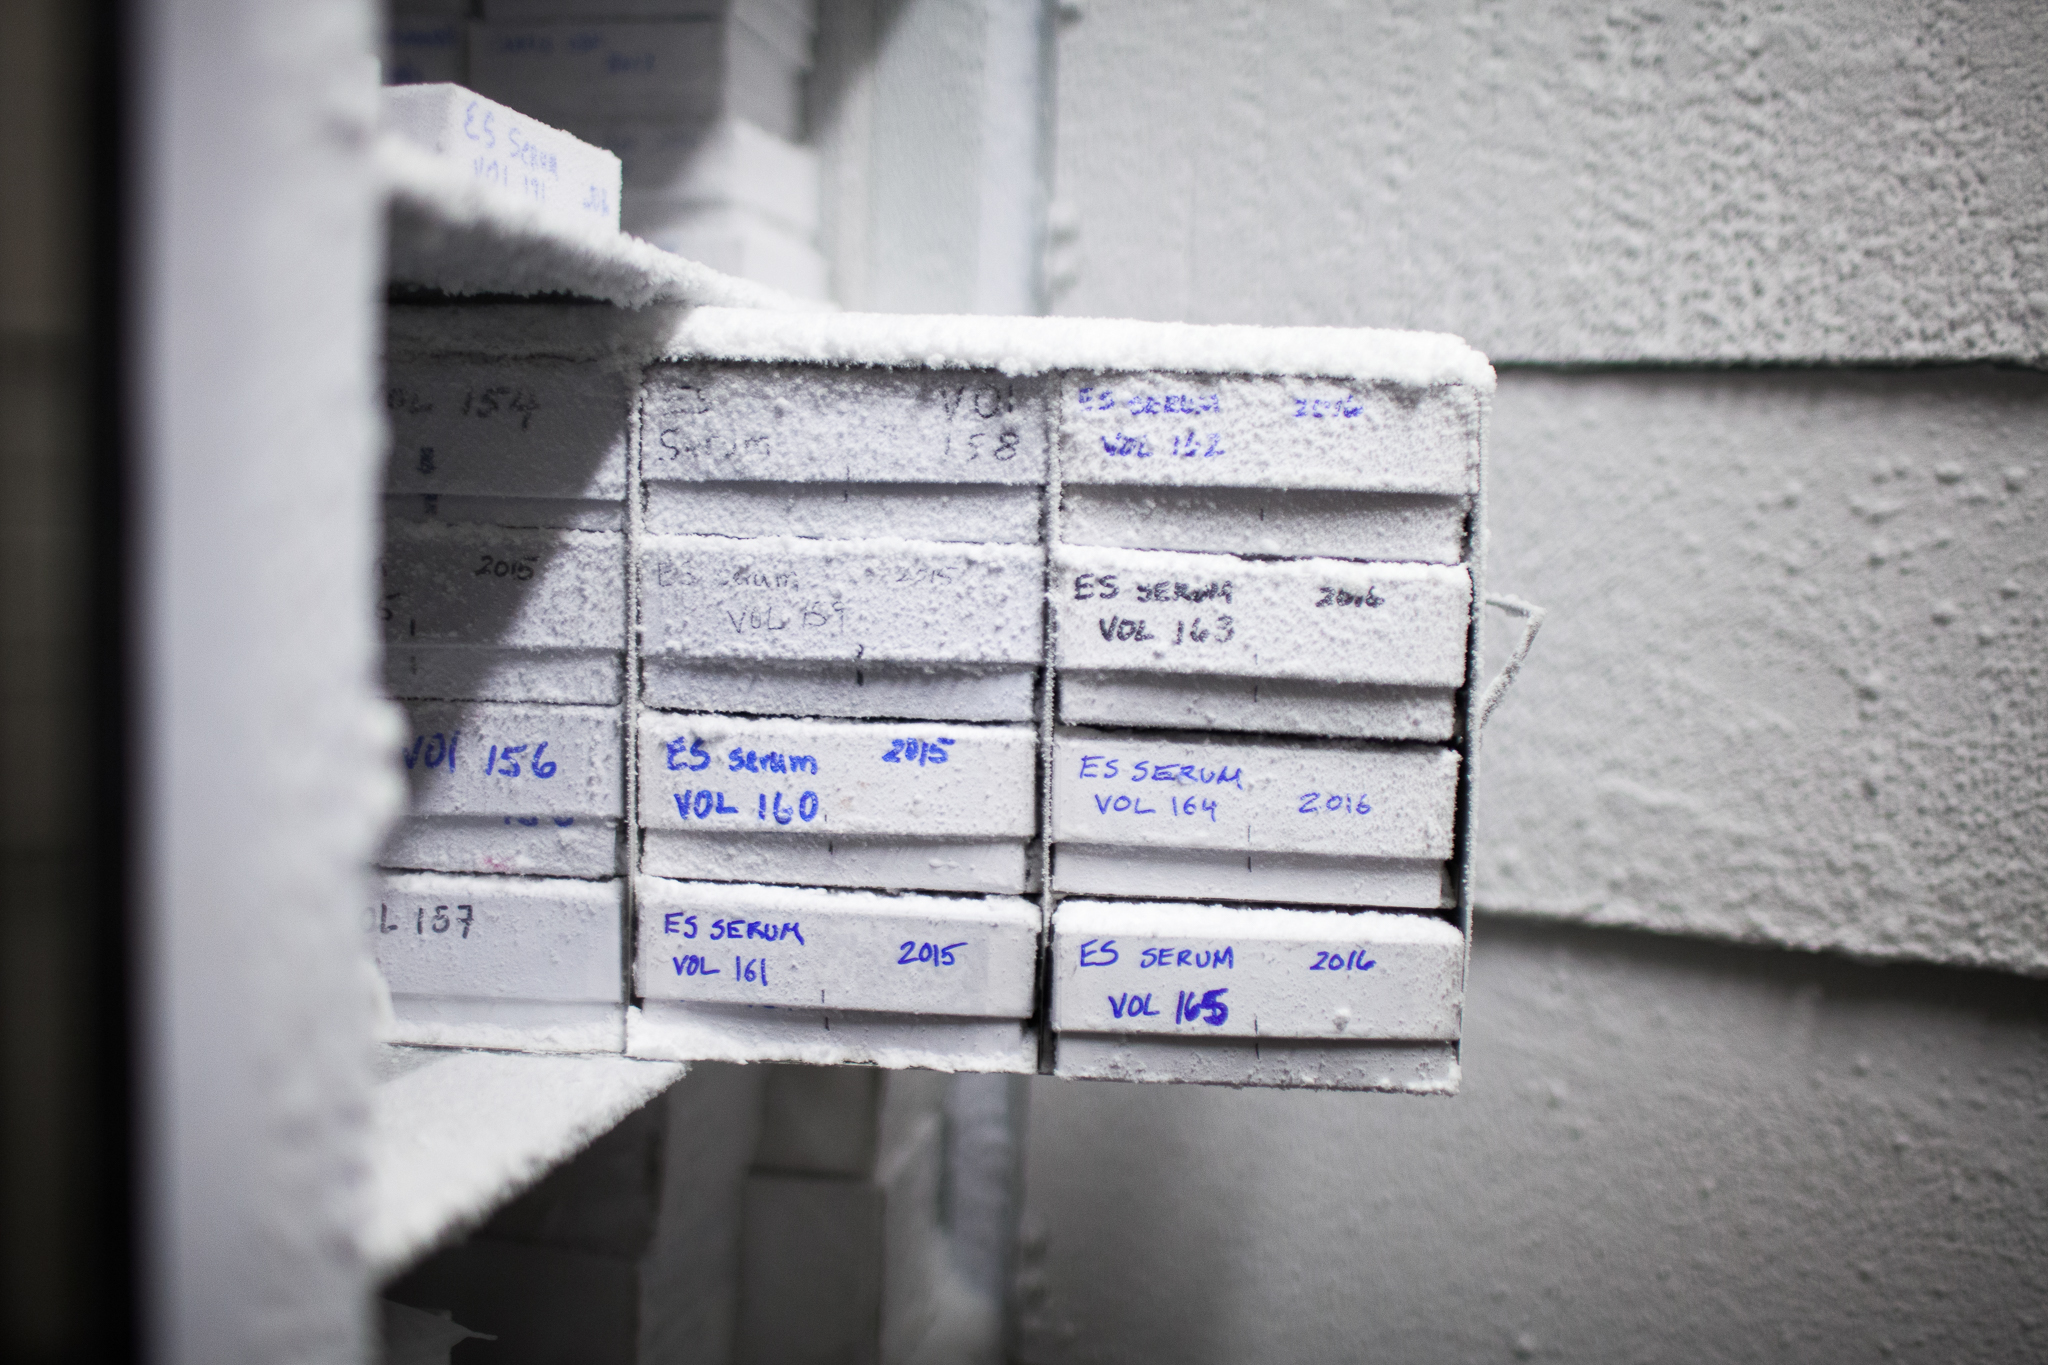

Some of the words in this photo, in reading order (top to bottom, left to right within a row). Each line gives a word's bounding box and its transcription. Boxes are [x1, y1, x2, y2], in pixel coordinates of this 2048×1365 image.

[464, 100, 495, 148] ES
[387, 387, 434, 415] OL
[461, 386, 541, 433] 154
[1079, 387, 1116, 412] ES
[1293, 393, 1364, 419] 2016
[943, 431, 1020, 461] 158
[1099, 431, 1154, 459] VOL
[1172, 430, 1226, 459] 162
[474, 554, 541, 582] 2015
[658, 560, 701, 588] ES
[1074, 572, 1120, 601] ES
[1136, 579, 1234, 604] SERUM
[1314, 585, 1386, 609] 2016
[726, 604, 791, 635] VOL
[1099, 614, 1155, 643] VOL
[1172, 613, 1236, 647] 163
[484, 740, 557, 780] 156
[664, 735, 712, 773] ES
[728, 746, 819, 775] serum
[881, 737, 957, 768] 2015
[1079, 755, 1119, 780] ES
[1131, 760, 1244, 791] SERUM
[673, 788, 740, 821] VOL
[758, 789, 820, 826] 160
[1094, 793, 1157, 816] VOL
[1171, 795, 1218, 823] 164
[1298, 792, 1373, 816] 2016
[416, 903, 475, 939] 157
[664, 911, 699, 940] ES
[709, 918, 806, 946] SERUM
[896, 940, 969, 967] 2015
[1080, 939, 1120, 967] ES
[1140, 945, 1236, 971] SERUM
[1309, 949, 1378, 972] 2016
[673, 955, 722, 977] VOL
[735, 955, 769, 987] 161
[1107, 991, 1162, 1020] VOL
[1175, 987, 1230, 1027] 165
